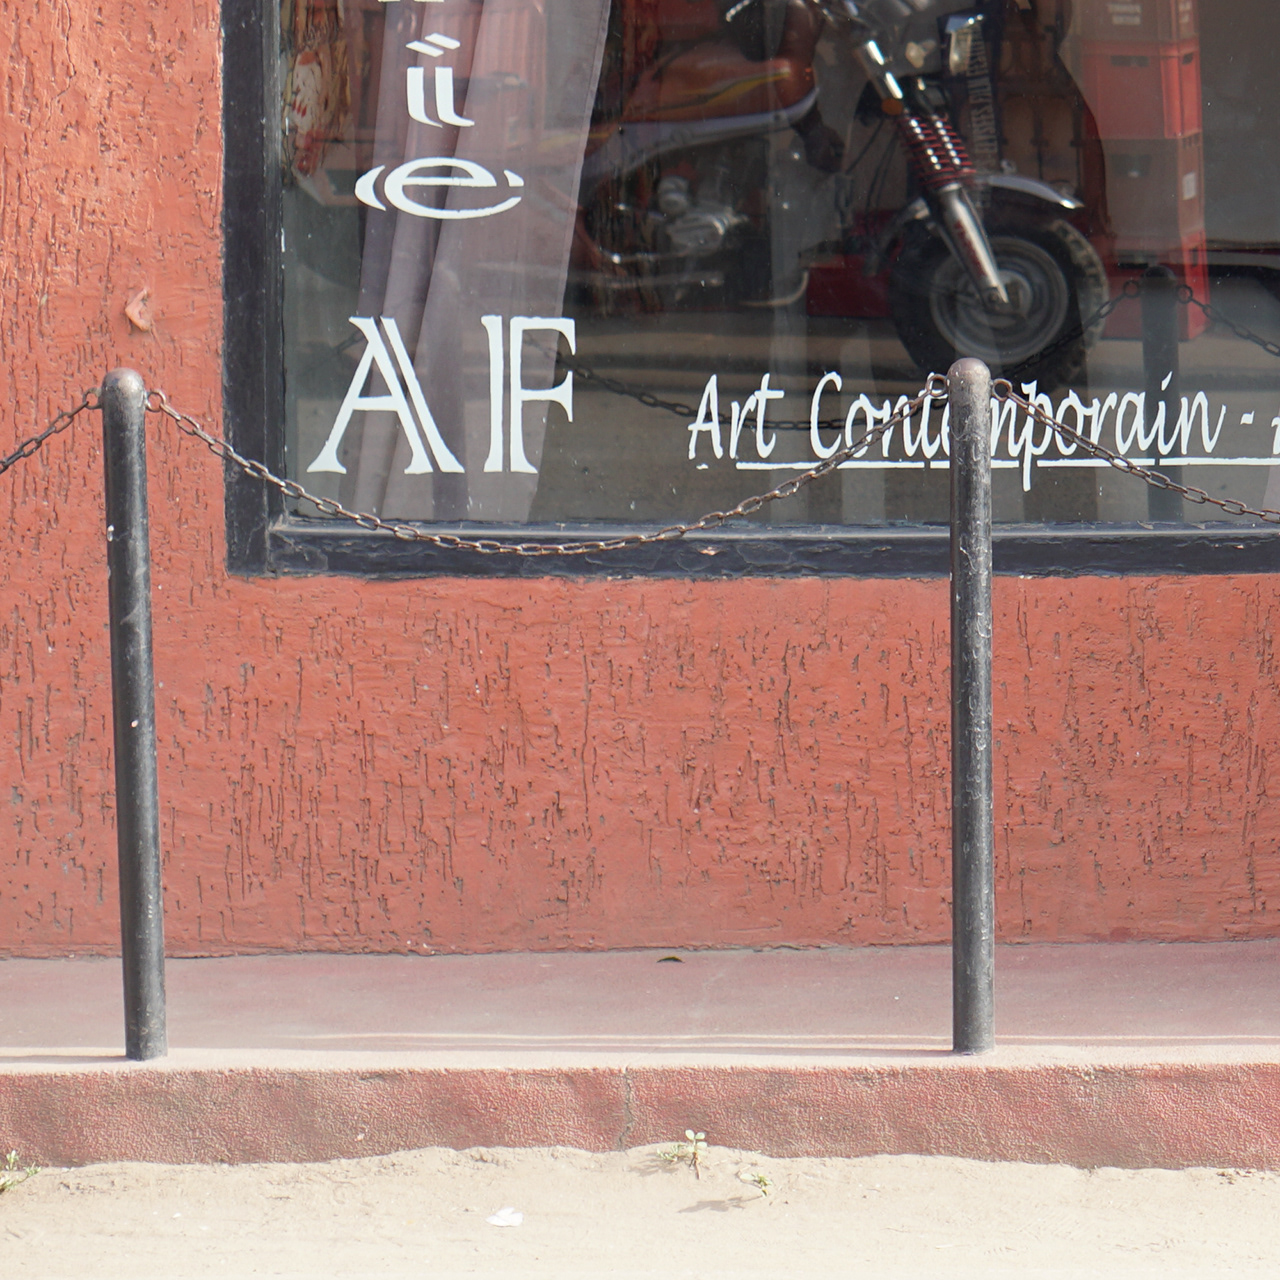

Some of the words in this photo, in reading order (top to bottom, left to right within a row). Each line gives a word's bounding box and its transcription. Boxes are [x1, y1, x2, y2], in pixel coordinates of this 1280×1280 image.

[306, 315, 577, 475] AF
[687, 372, 785, 460] Art
[810, 371, 1228, 493] Contmporain
